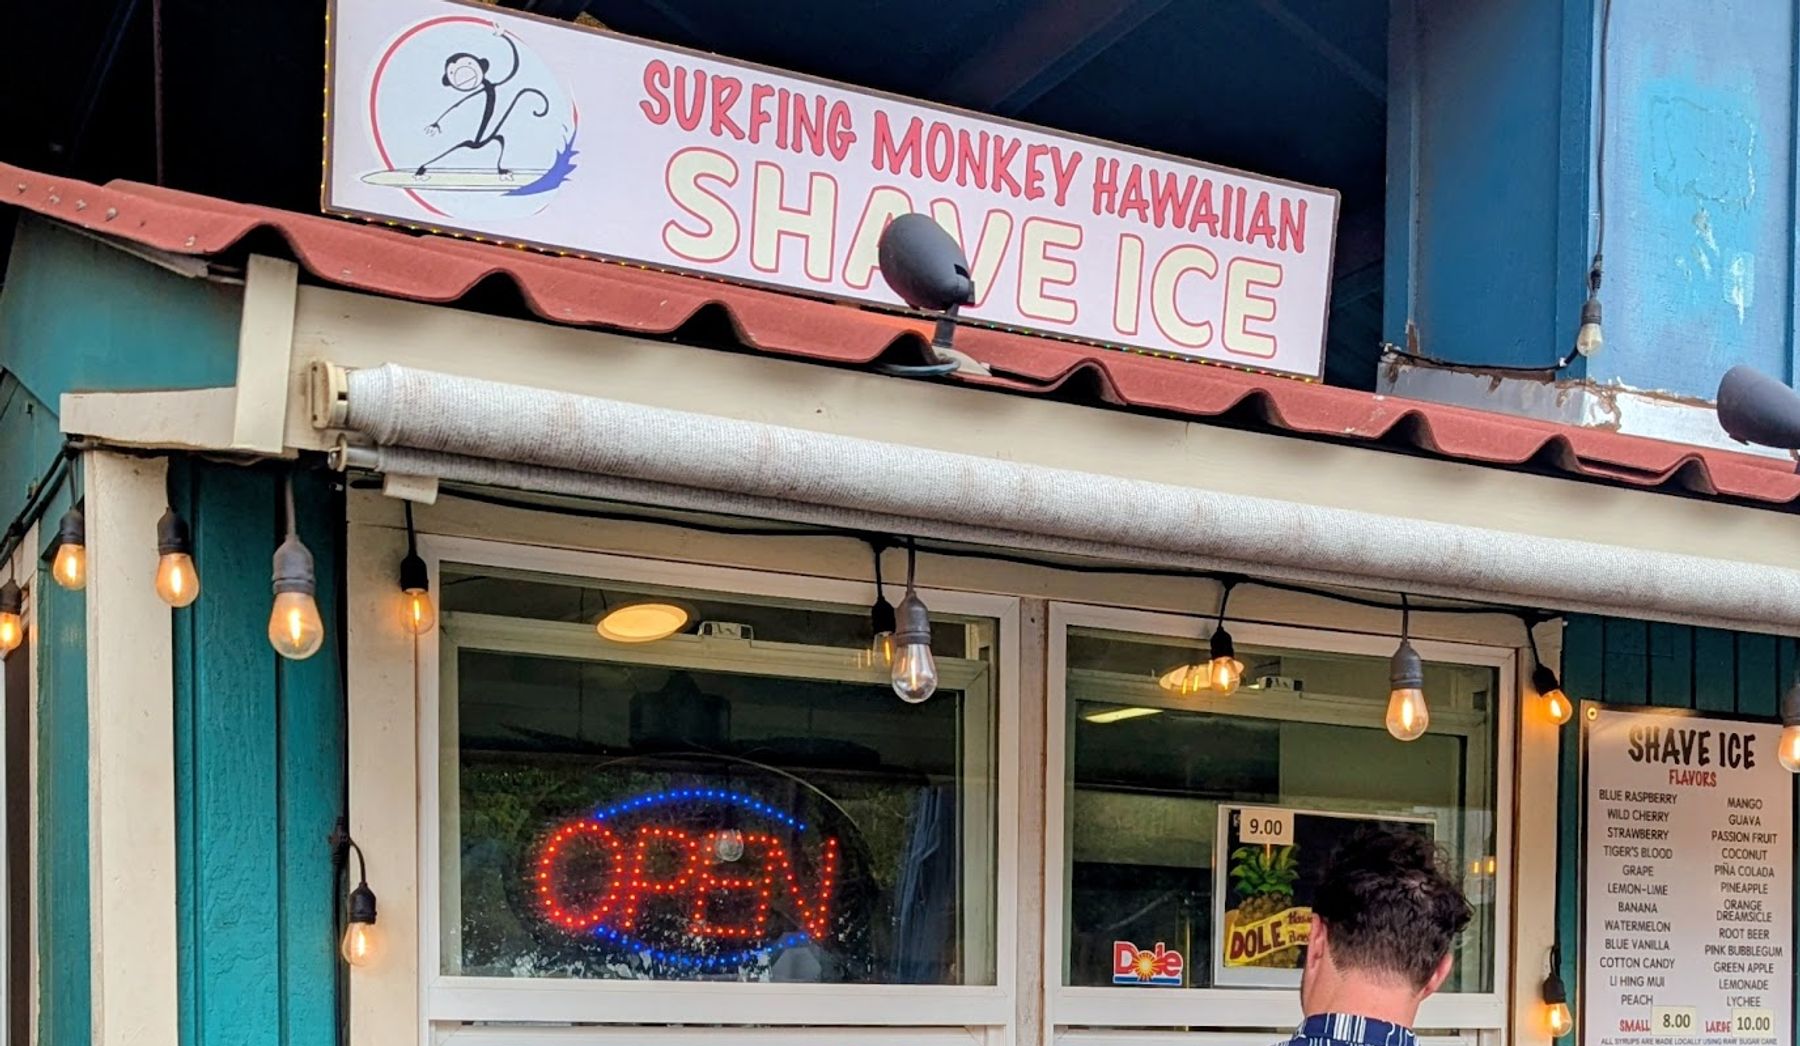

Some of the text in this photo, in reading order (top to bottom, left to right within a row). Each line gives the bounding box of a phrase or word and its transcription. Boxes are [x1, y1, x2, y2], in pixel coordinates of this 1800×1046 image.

[640, 60, 1308, 253] SURFING MONKEY HAWAIIAN
[662, 147, 1283, 359] SHAVE ICE
[1628, 726, 1755, 769] SHAVE ICE
[1669, 769, 1717, 787] FLAVORS
[1599, 789, 1677, 804] BLUE RASPBERRY
[1727, 797, 1762, 809] MANGO
[1607, 808, 1670, 822] WILD CHERRY
[1728, 814, 1761, 826] GUAVA
[1250, 818, 1282, 836] 9.00
[1607, 827, 1669, 840] STRAWBERRY
[1711, 830, 1777, 844] PASSION FRUIT
[1603, 845, 1673, 859] TIGER'S BLOOD
[1721, 847, 1767, 860] COCONUT
[1622, 864, 1654, 877] GRAPE
[1714, 861, 1775, 878] PIÑA COLADA
[537, 818, 840, 938] OPEN
[1607, 883, 1668, 896] LEMON-LIME
[1720, 881, 1768, 895] PINEAPPLE
[1618, 902, 1658, 914] BANANA
[1723, 899, 1762, 911] ORANGE
[1716, 910, 1772, 923] DREAMSICLE
[1604, 920, 1671, 933] WATERMELON
[1229, 920, 1286, 960] DOLE
[1719, 928, 1770, 940] ROOT BEER
[1605, 938, 1670, 951] BLUE VANILLA
[1704, 944, 1783, 957] PINK BUBBLEGUM
[1114, 943, 1183, 977] Dole
[1600, 956, 1675, 969] COTTON CANDY
[1713, 961, 1775, 974] GREEN APPLE
[1610, 975, 1665, 988] LI HING MUI
[1718, 979, 1769, 991] LEMONADE
[1621, 994, 1653, 1006] PEACH
[1727, 996, 1761, 1008] LYCHEE
[1619, 1019, 1650, 1032] SMALL
[1662, 1013, 1691, 1029] 8.00
[1737, 1016, 1770, 1031] 10.00
[1703, 1038, 1722, 1046] USING
